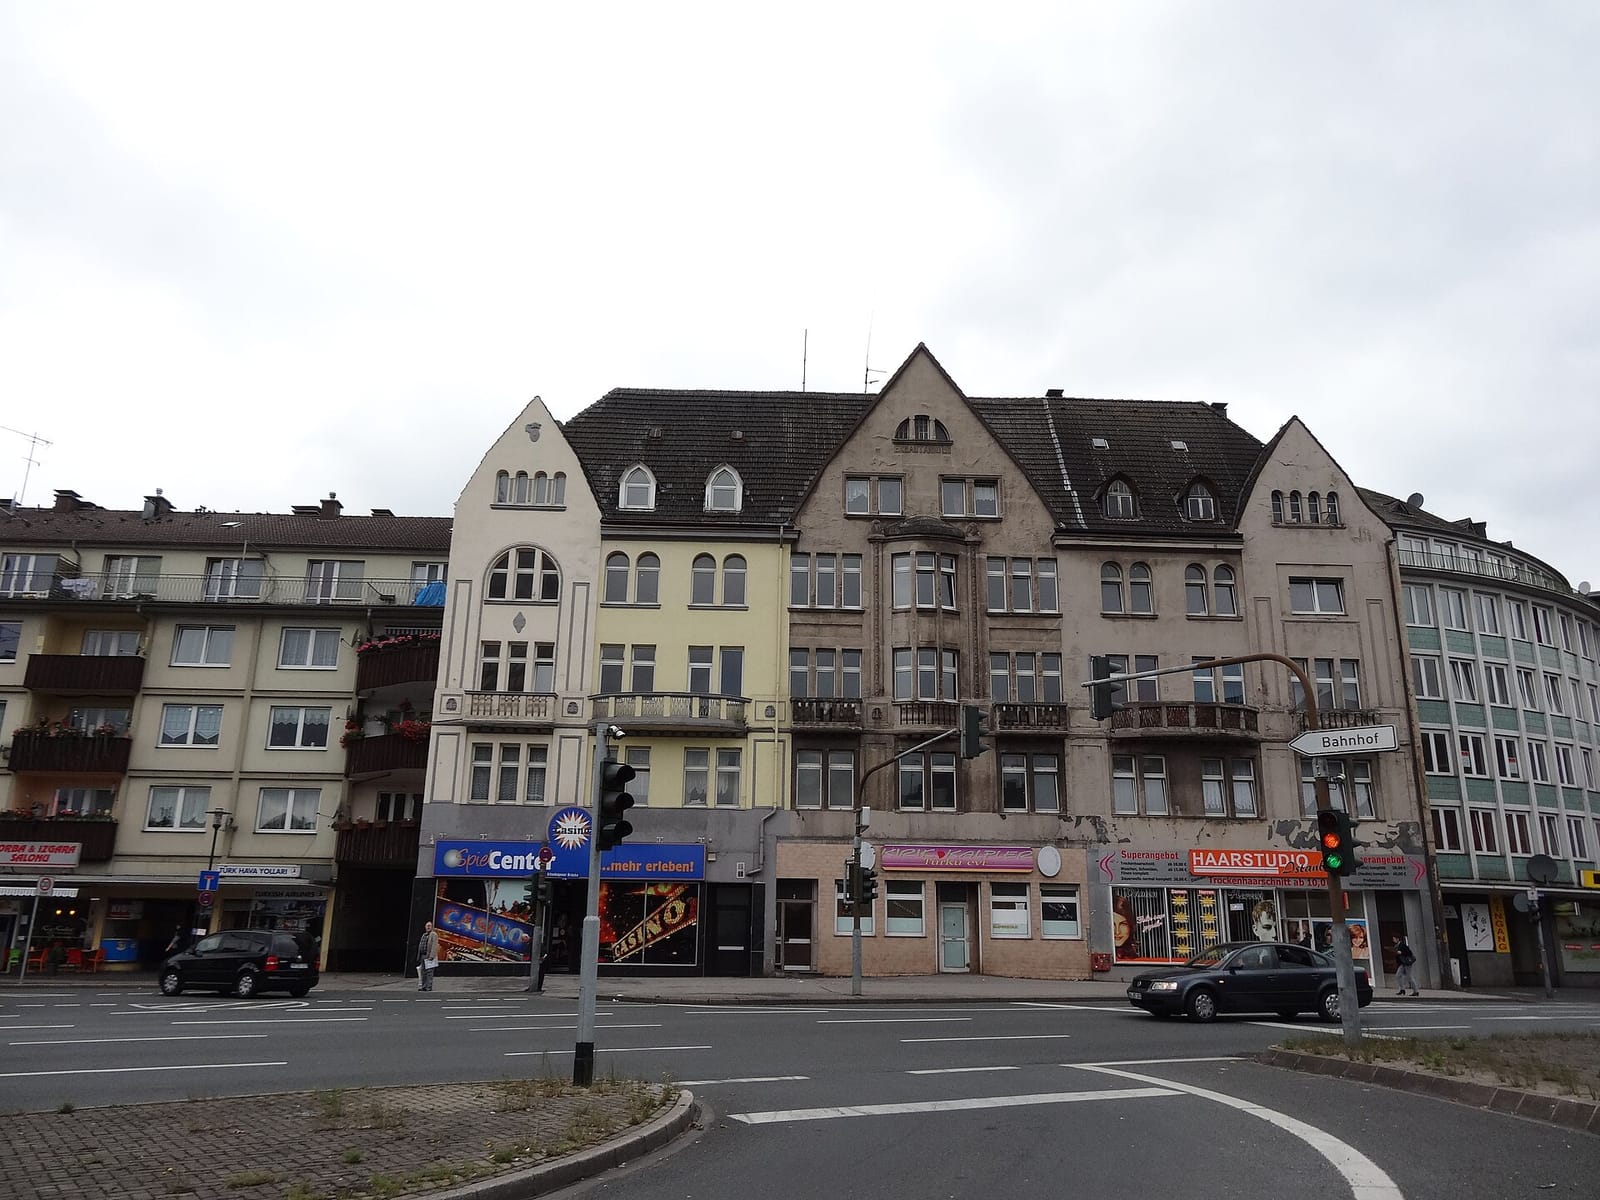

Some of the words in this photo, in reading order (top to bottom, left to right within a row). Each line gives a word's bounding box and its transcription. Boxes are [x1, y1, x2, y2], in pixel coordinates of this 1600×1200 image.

[1322, 732, 1380, 748] Bahnhof
[39, 846, 77, 854] IZGARA
[1121, 850, 1179, 861] Superangebot
[1192, 852, 1309, 868] HAARSTUDIO
[1282, 859, 1326, 873] Istanb
[1360, 856, 1406, 865] erangebot
[238, 867, 258, 875] HAVA
[260, 867, 288, 876] YOLLARI
[646, 861, 694, 872] erleben!
[1209, 876, 1291, 887] Trockenhaarschnitt
[1294, 878, 1304, 887] ab
[1308, 878, 1329, 888] 10,0
[443, 908, 524, 944] CASINO
[615, 900, 687, 957] CASINO
